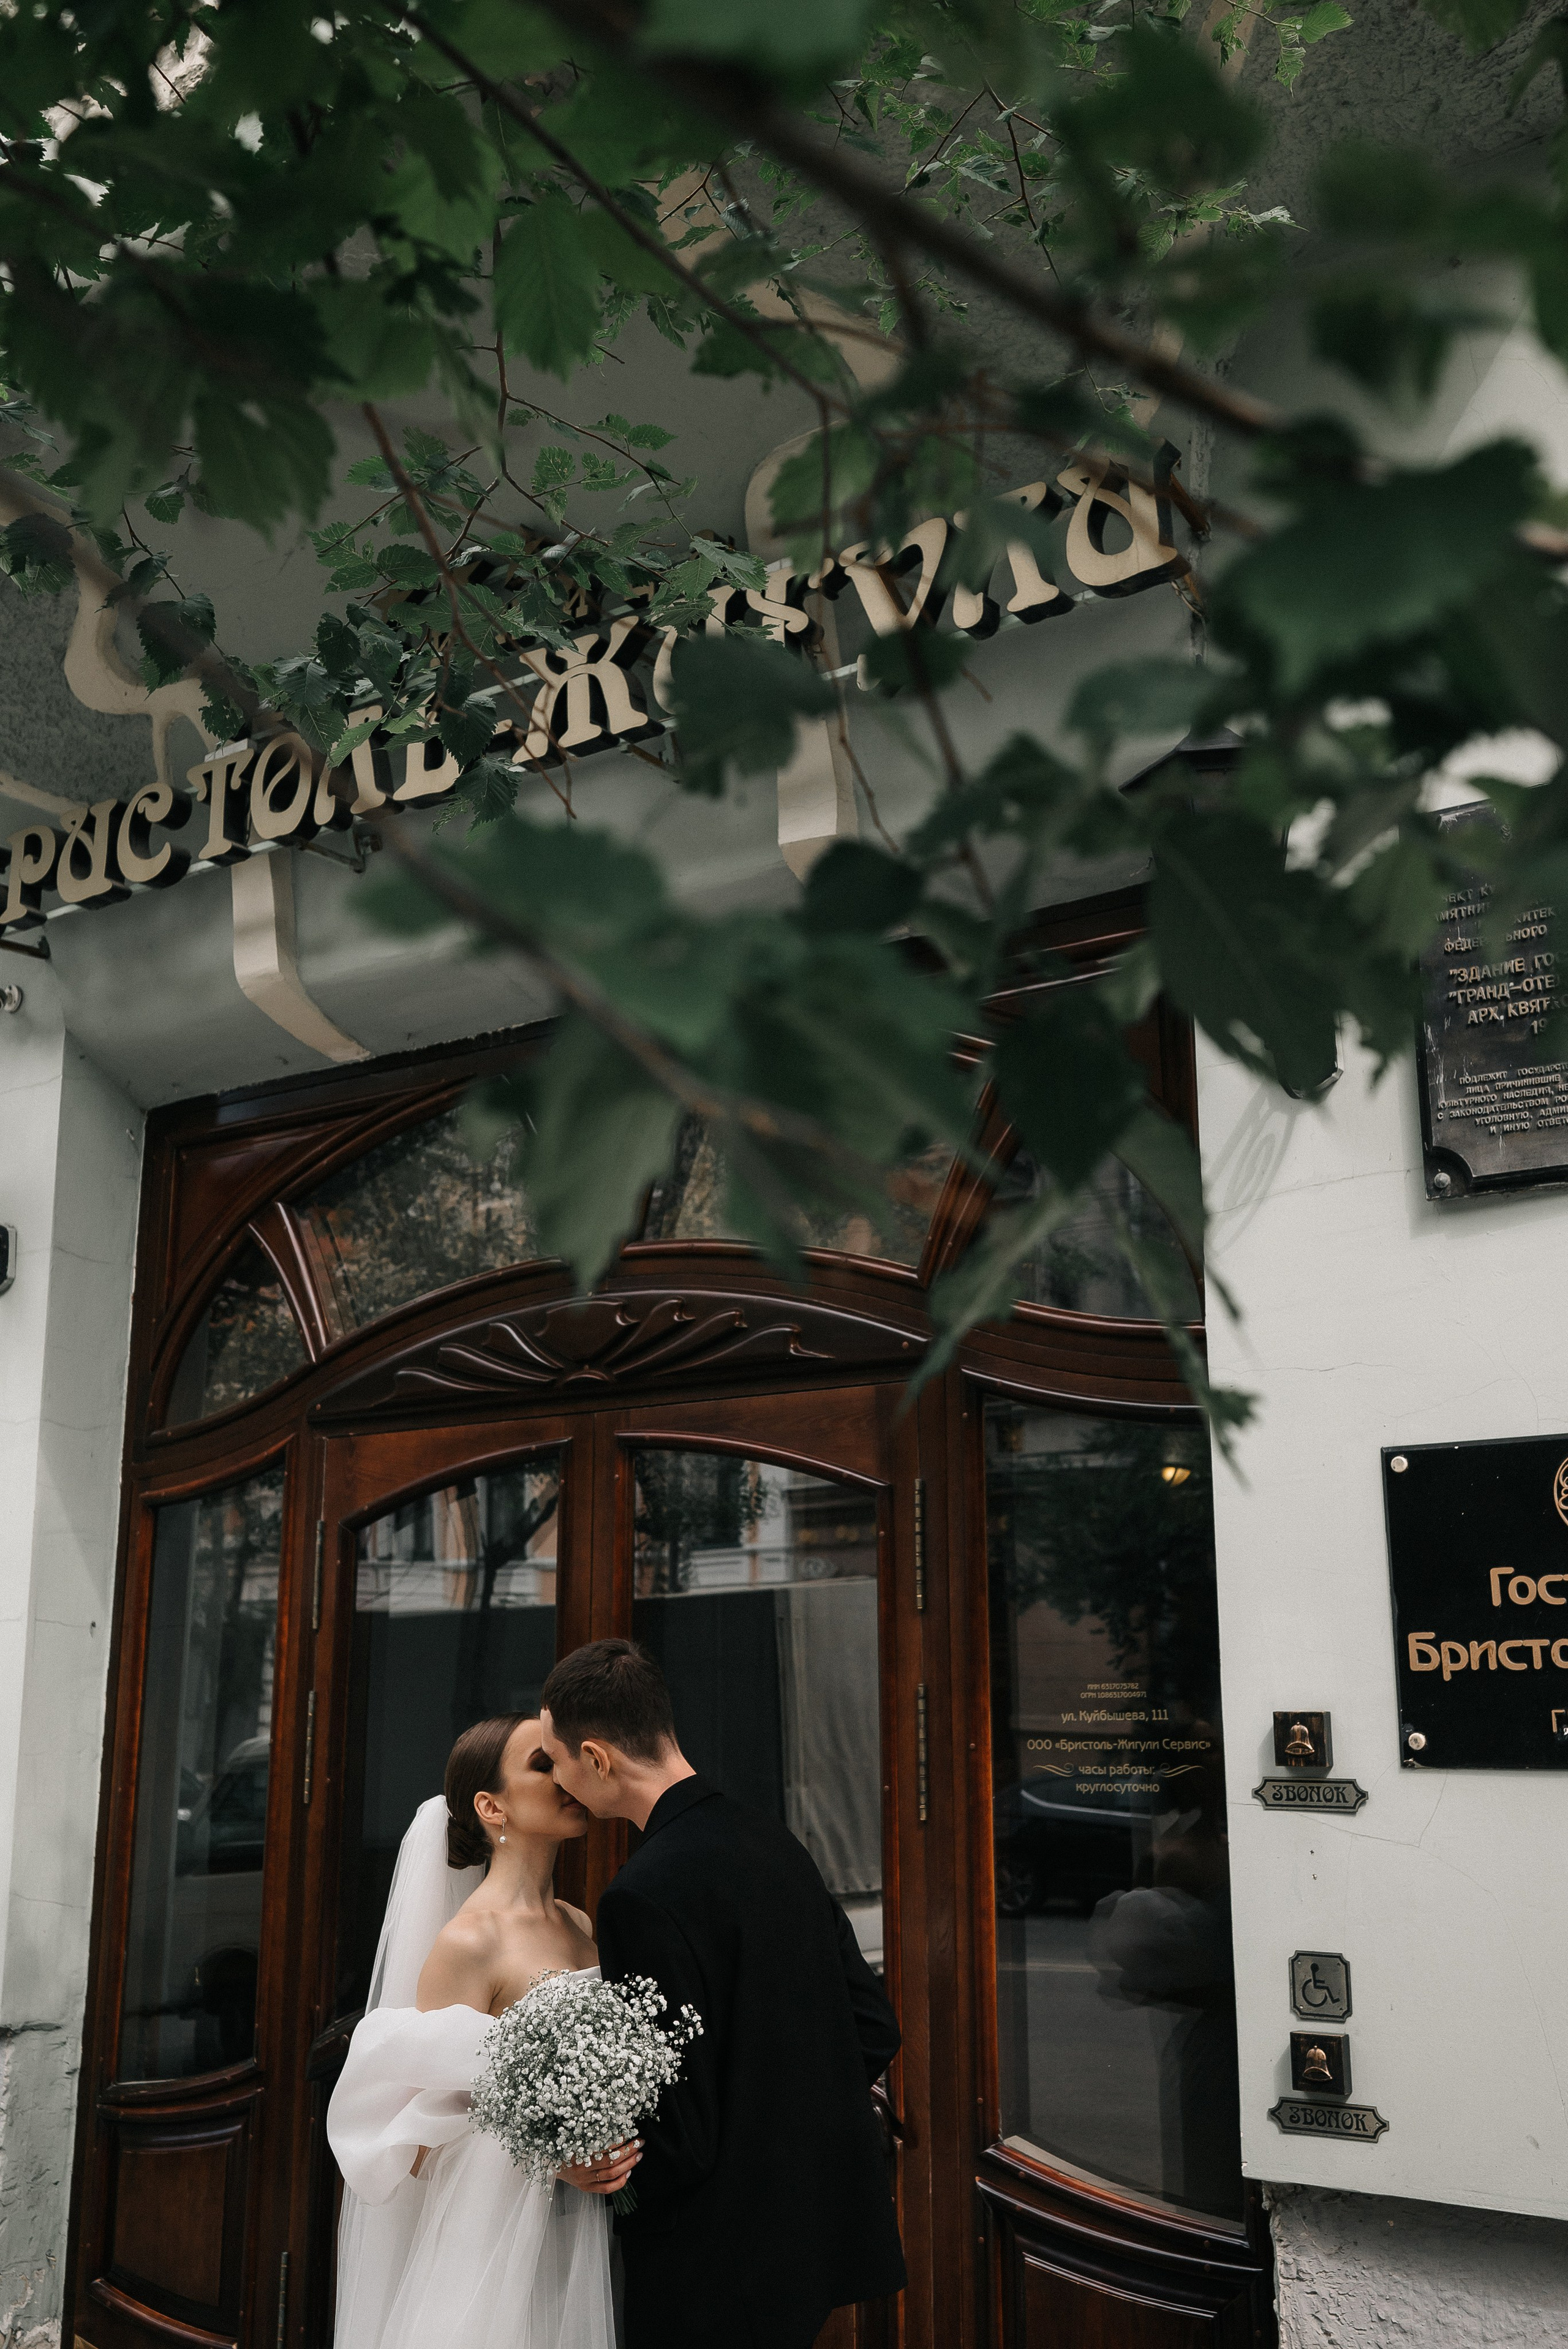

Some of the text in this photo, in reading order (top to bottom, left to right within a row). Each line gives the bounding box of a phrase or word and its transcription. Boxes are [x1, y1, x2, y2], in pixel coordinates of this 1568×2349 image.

[1449, 975, 1560, 1005] "ГРАНД-ОТЕ
[1468, 1006, 1504, 1025] АРХ.
[1459, 1071, 1507, 1085] ПОДЛЕЖИТ
[1466, 1085, 1490, 1094] ЛИЦА
[1495, 1074, 1560, 1090] ПРИЧИНИВШИЕ
[1438, 1094, 1497, 1109] КУЛЬТУРНОГО
[1503, 1086, 1554, 1099] НАСЛЕДИЯ,
[1450, 1098, 1548, 1118] ЗАКОНОДАТЕЛЬСТВОМ
[1555, 1095, 1568, 1103] РО
[1475, 1111, 1532, 1125] УГОЛОВНУЮ,
[1504, 1122, 1530, 1131] ИНУЮ
[1490, 1567, 1568, 1607] Гос
[1061, 1709, 1169, 1724] ул. Куйбышева, 111
[1027, 1738, 1211, 1752] ООО «Бристоль-Жигули Сервис»
[1079, 1763, 1156, 1777] часы работы:
[1076, 1782, 1160, 1795] круглосуточно
[1272, 1784, 1349, 1804] ЗВОНОК
[1289, 2106, 1369, 2132] ЗВОНОК
